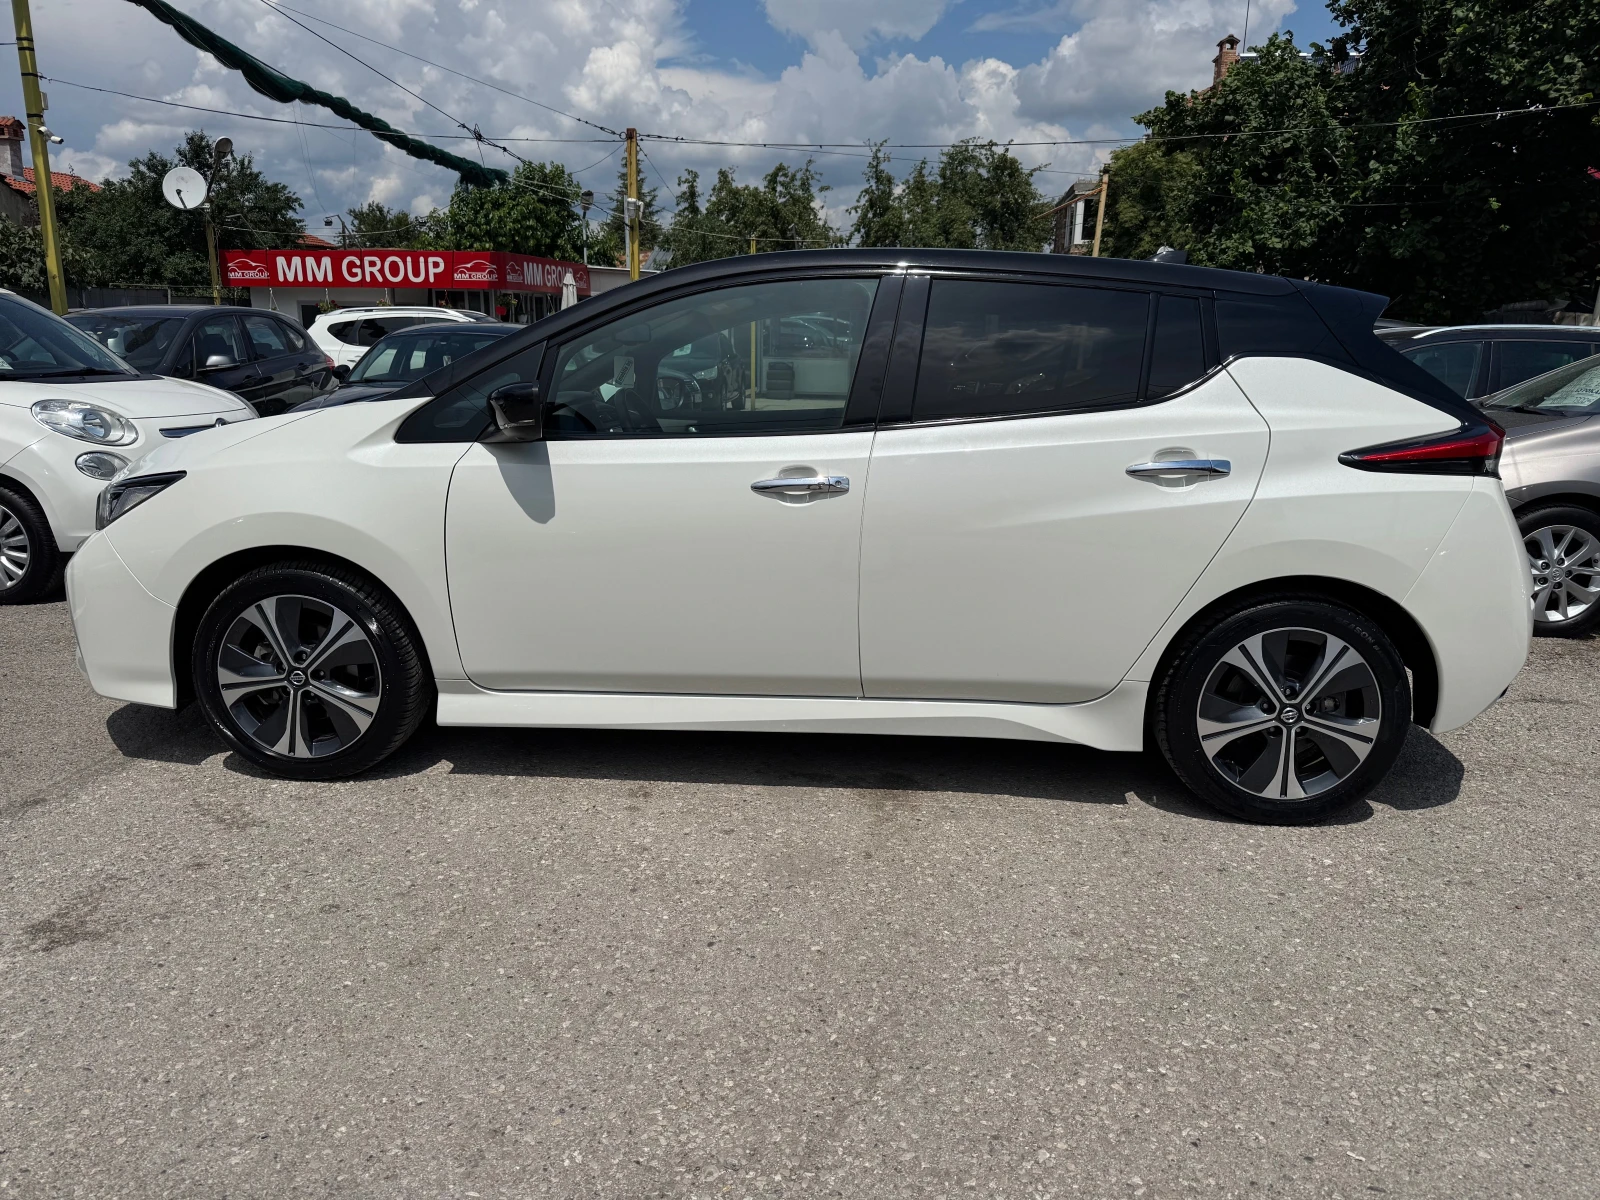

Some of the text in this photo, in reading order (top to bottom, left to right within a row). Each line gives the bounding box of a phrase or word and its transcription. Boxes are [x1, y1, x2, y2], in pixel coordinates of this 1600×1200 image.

[276, 256, 445, 283] MM GROUP
[523, 261, 543, 286] MM
